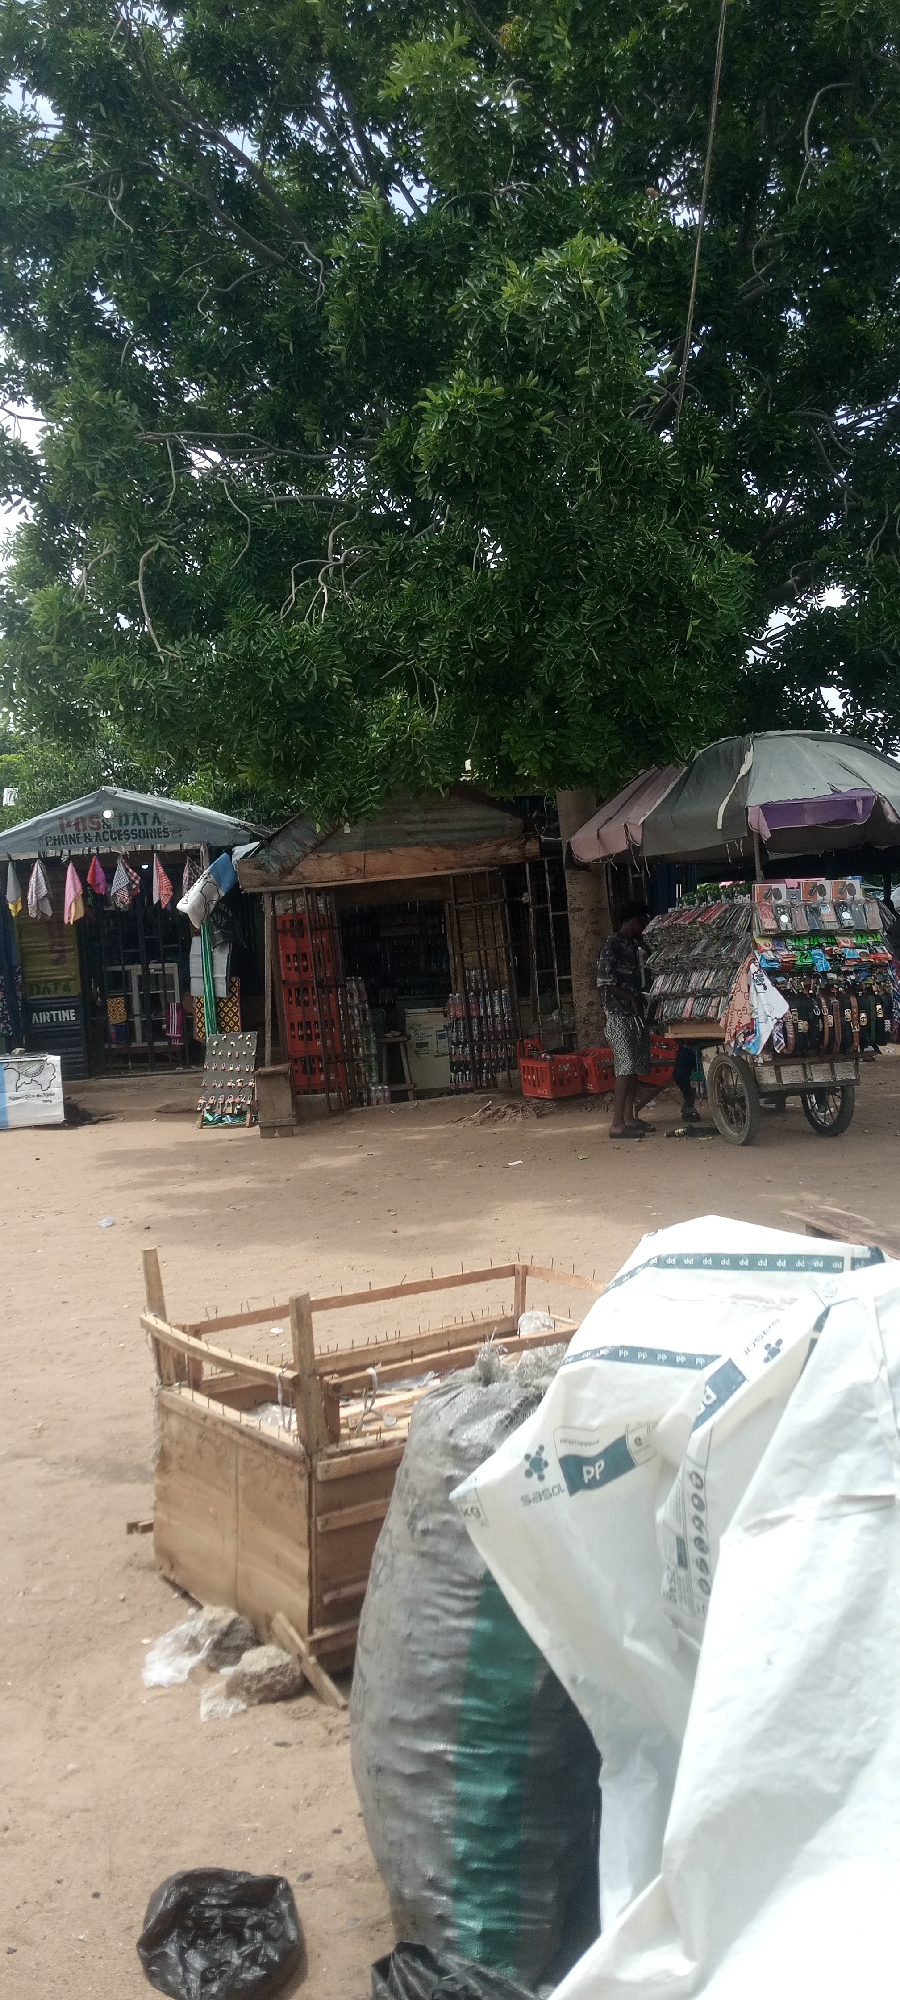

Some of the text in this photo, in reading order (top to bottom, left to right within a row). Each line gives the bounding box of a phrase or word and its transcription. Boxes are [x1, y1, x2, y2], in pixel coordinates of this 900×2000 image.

[118, 812, 162, 827] DATA
[45, 832, 82, 847] PHONE
[94, 827, 171, 843] ACCESSORIES
[32, 1009, 76, 1024] AIRTIME
